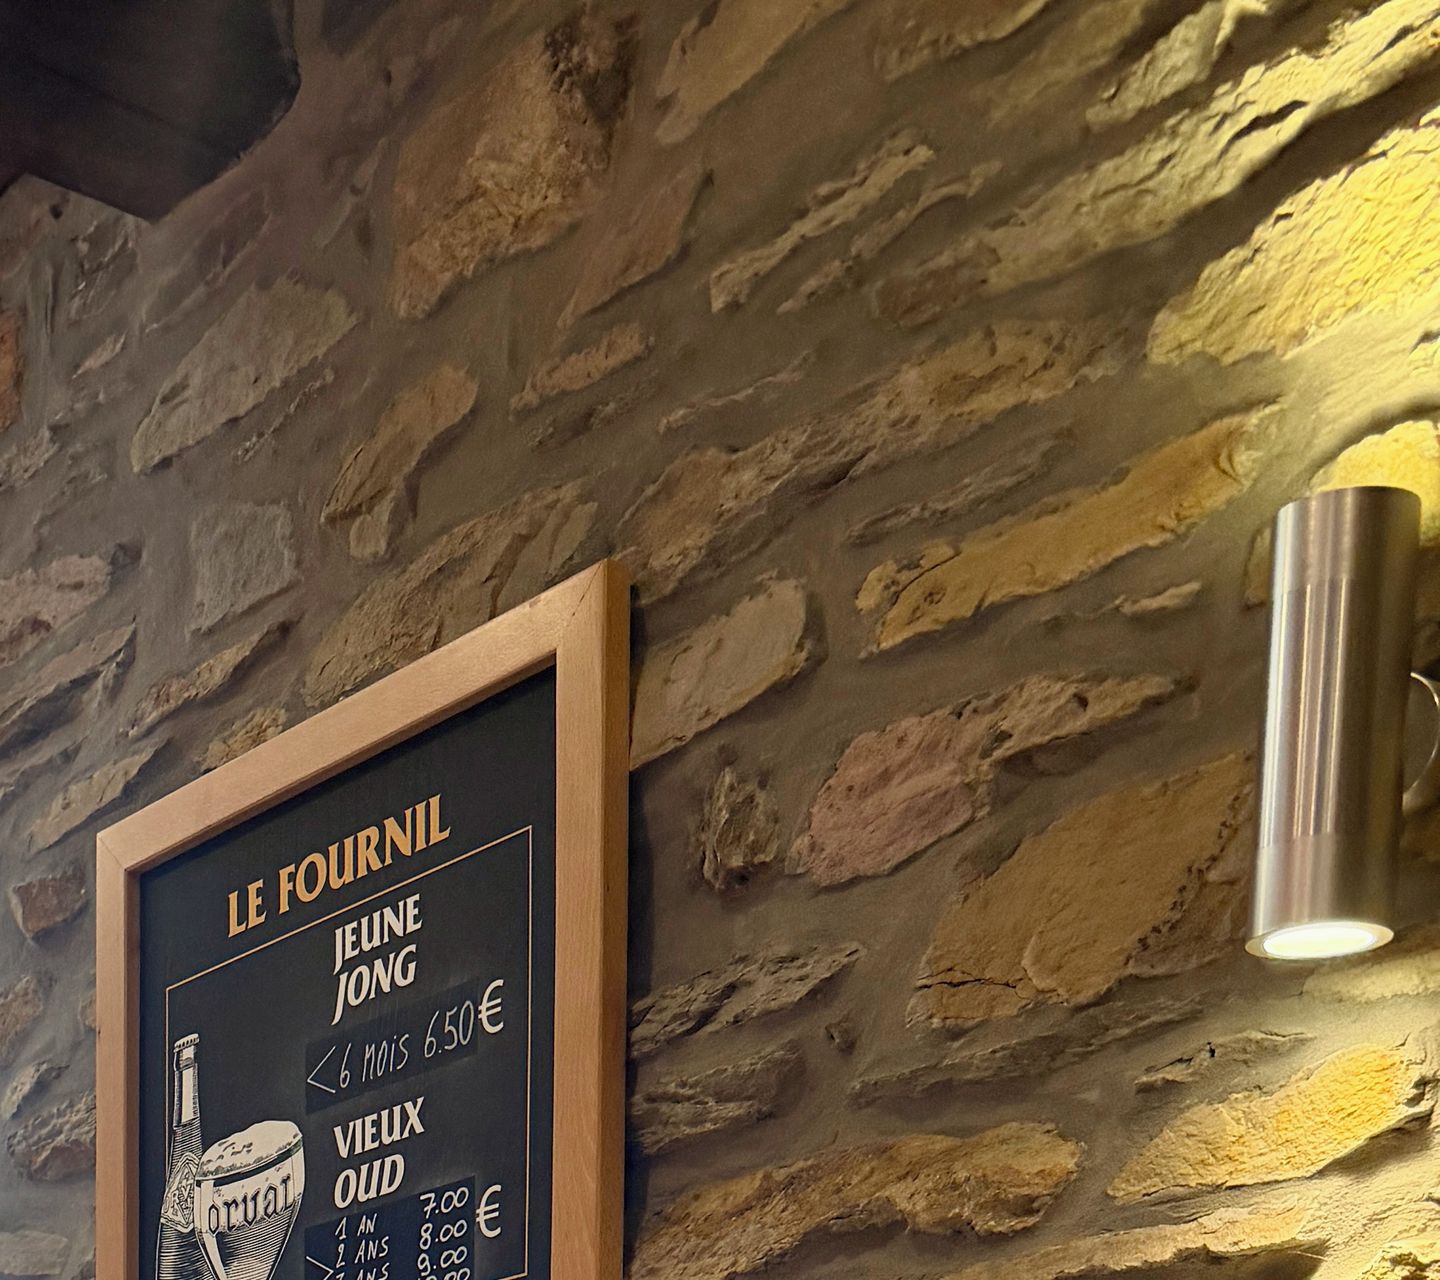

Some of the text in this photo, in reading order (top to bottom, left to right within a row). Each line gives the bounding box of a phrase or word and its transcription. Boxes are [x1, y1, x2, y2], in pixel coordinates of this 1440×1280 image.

[228, 794, 450, 938] LE FOURNIL
[334, 894, 423, 975] JEUNE
[332, 944, 417, 1025] JONG
[334, 1096, 425, 1159] VIEUX
[334, 1153, 405, 1209] OUD
[335, 1187, 469, 1240] 1 AN 7.00
[476, 1184, 502, 1238] €
[336, 1220, 467, 1268] 2 ANS 8.00
[417, 1246, 467, 1276] 9.00
